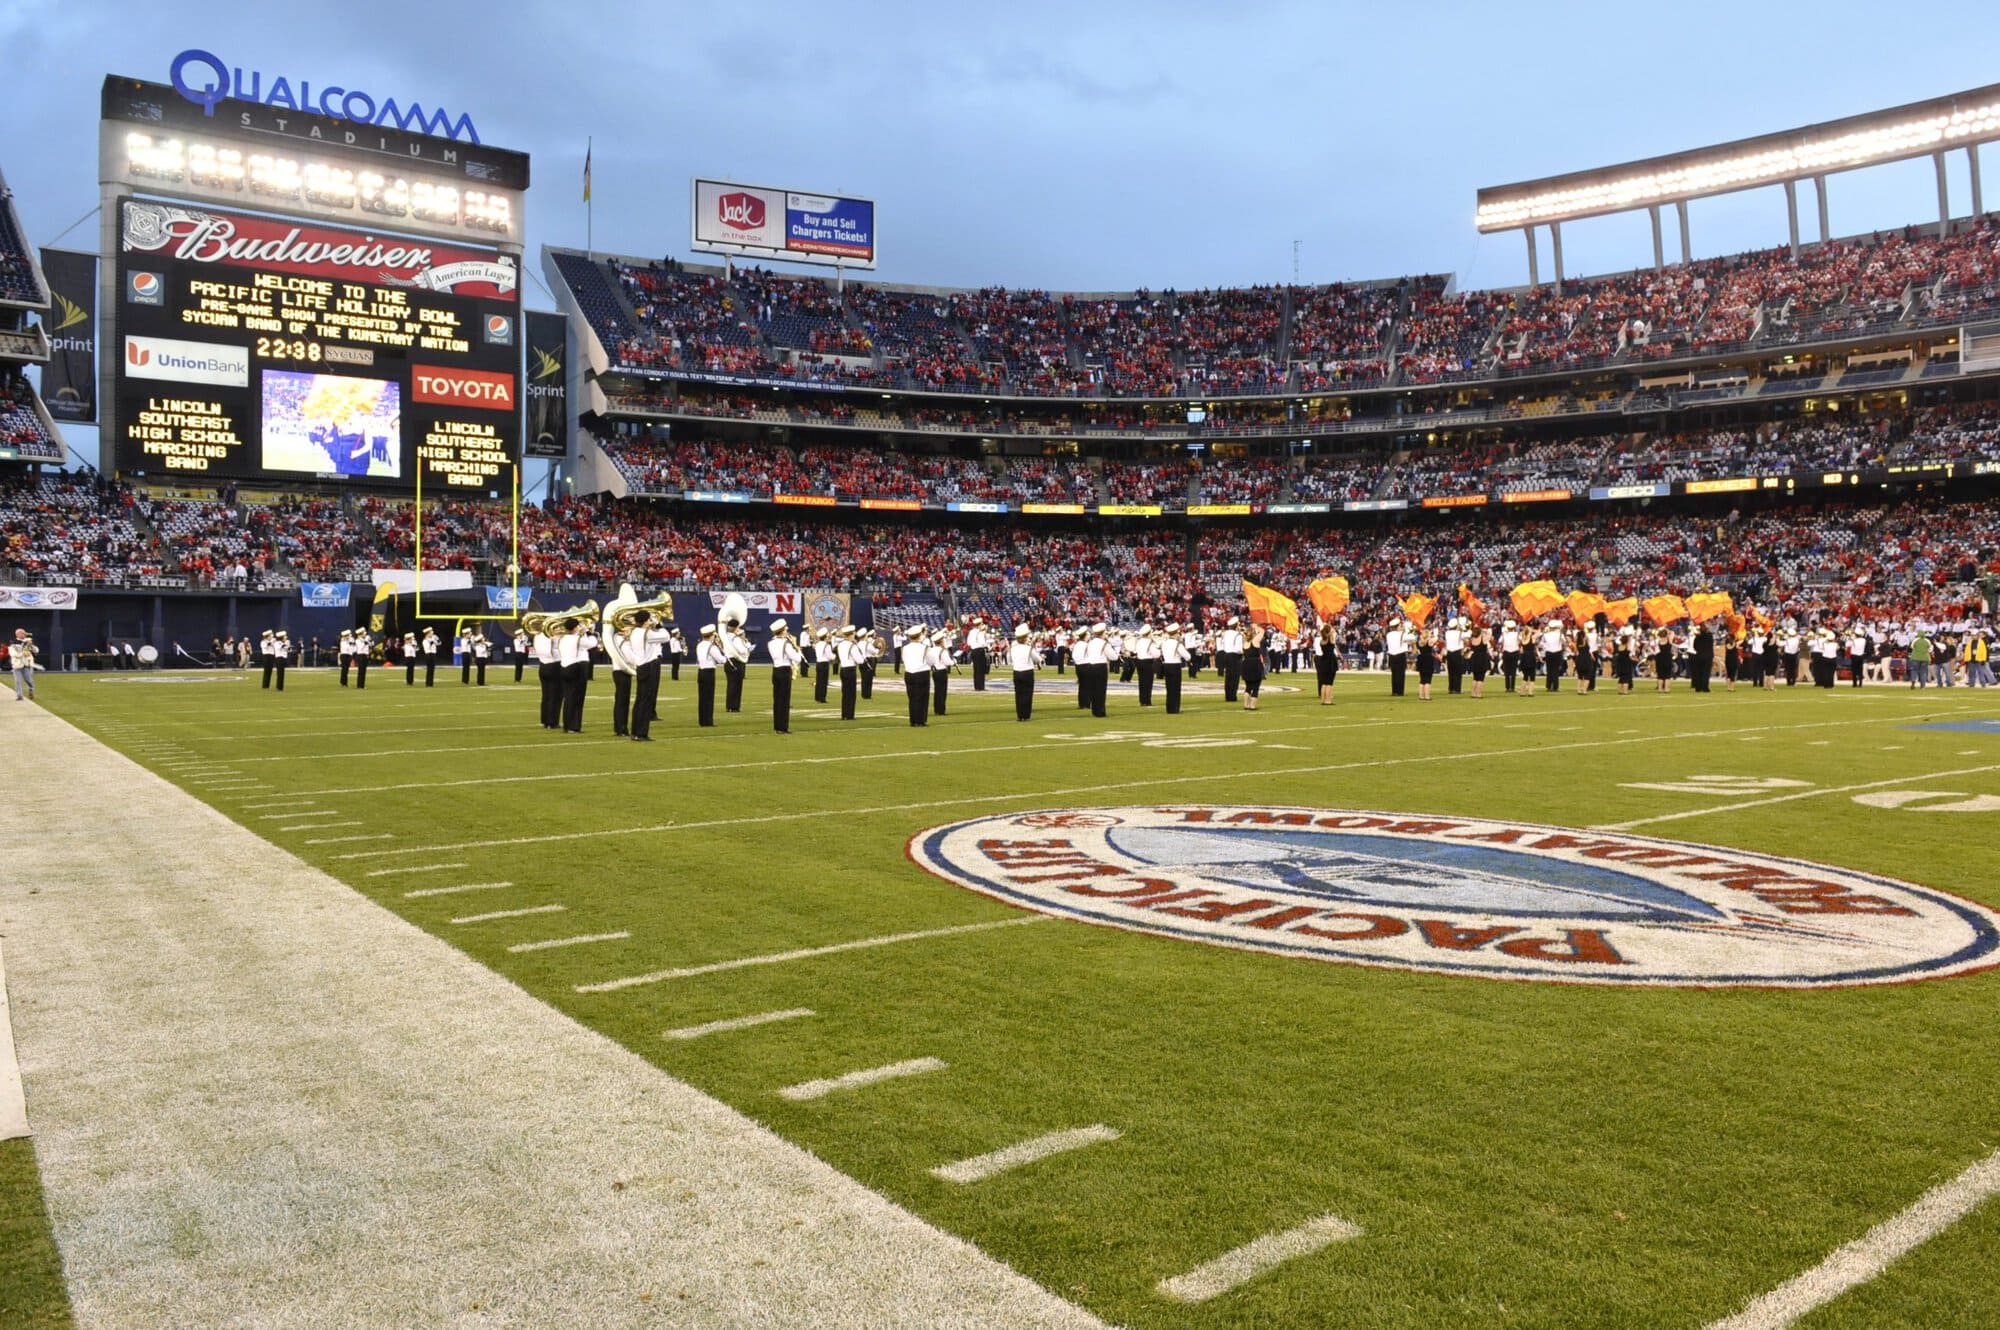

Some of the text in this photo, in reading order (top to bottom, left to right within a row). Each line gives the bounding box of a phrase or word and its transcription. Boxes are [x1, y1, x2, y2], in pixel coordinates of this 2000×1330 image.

[240, 112, 457, 162] STADIUM
[720, 197, 763, 226] Jack
[804, 213, 856, 230] Buy and Sell
[792, 225, 867, 243] Chargers Tickets!
[162, 219, 432, 269] Budweiser
[434, 267, 513, 284] American Lager
[255, 274, 406, 305] WELCOME TO THE
[191, 281, 461, 326] PACIFIC LIFE HOLIDAY BOWL
[201, 299, 453, 337] PRE-GAME SHOW PRESENTED BY THE
[182, 310, 469, 353] SYCUAN BAND OF THE KUMEYAAY NATION
[46, 334, 93, 353] Sprint
[257, 337, 321, 362] 22:38
[417, 376, 509, 401] TOYOTA
[527, 383, 565, 399] Sprint
[150, 398, 221, 415] LINCOLN
[139, 412, 231, 430] SOUTHEAST
[434, 421, 495, 436] LINCOLN
[129, 426, 242, 445] HIGH SCHOOL
[426, 434, 503, 450] SOUTHEAST
[144, 441, 227, 458] MARCHING
[417, 446, 511, 463] HIGH SCHOOL
[166, 456, 208, 470] BAND
[430, 462, 499, 475] MARCHING
[448, 475, 483, 486] BAND
[775, 495, 835, 505] WELLS FARGO
[1608, 485, 1655, 498] GEICO
[1424, 496, 1487, 507] WELLS FARGO
[776, 594, 794, 612] N
[1152, 809, 1921, 918] HOLIDAY BOWL
[976, 838, 1630, 965] PACIFIC LIFE
